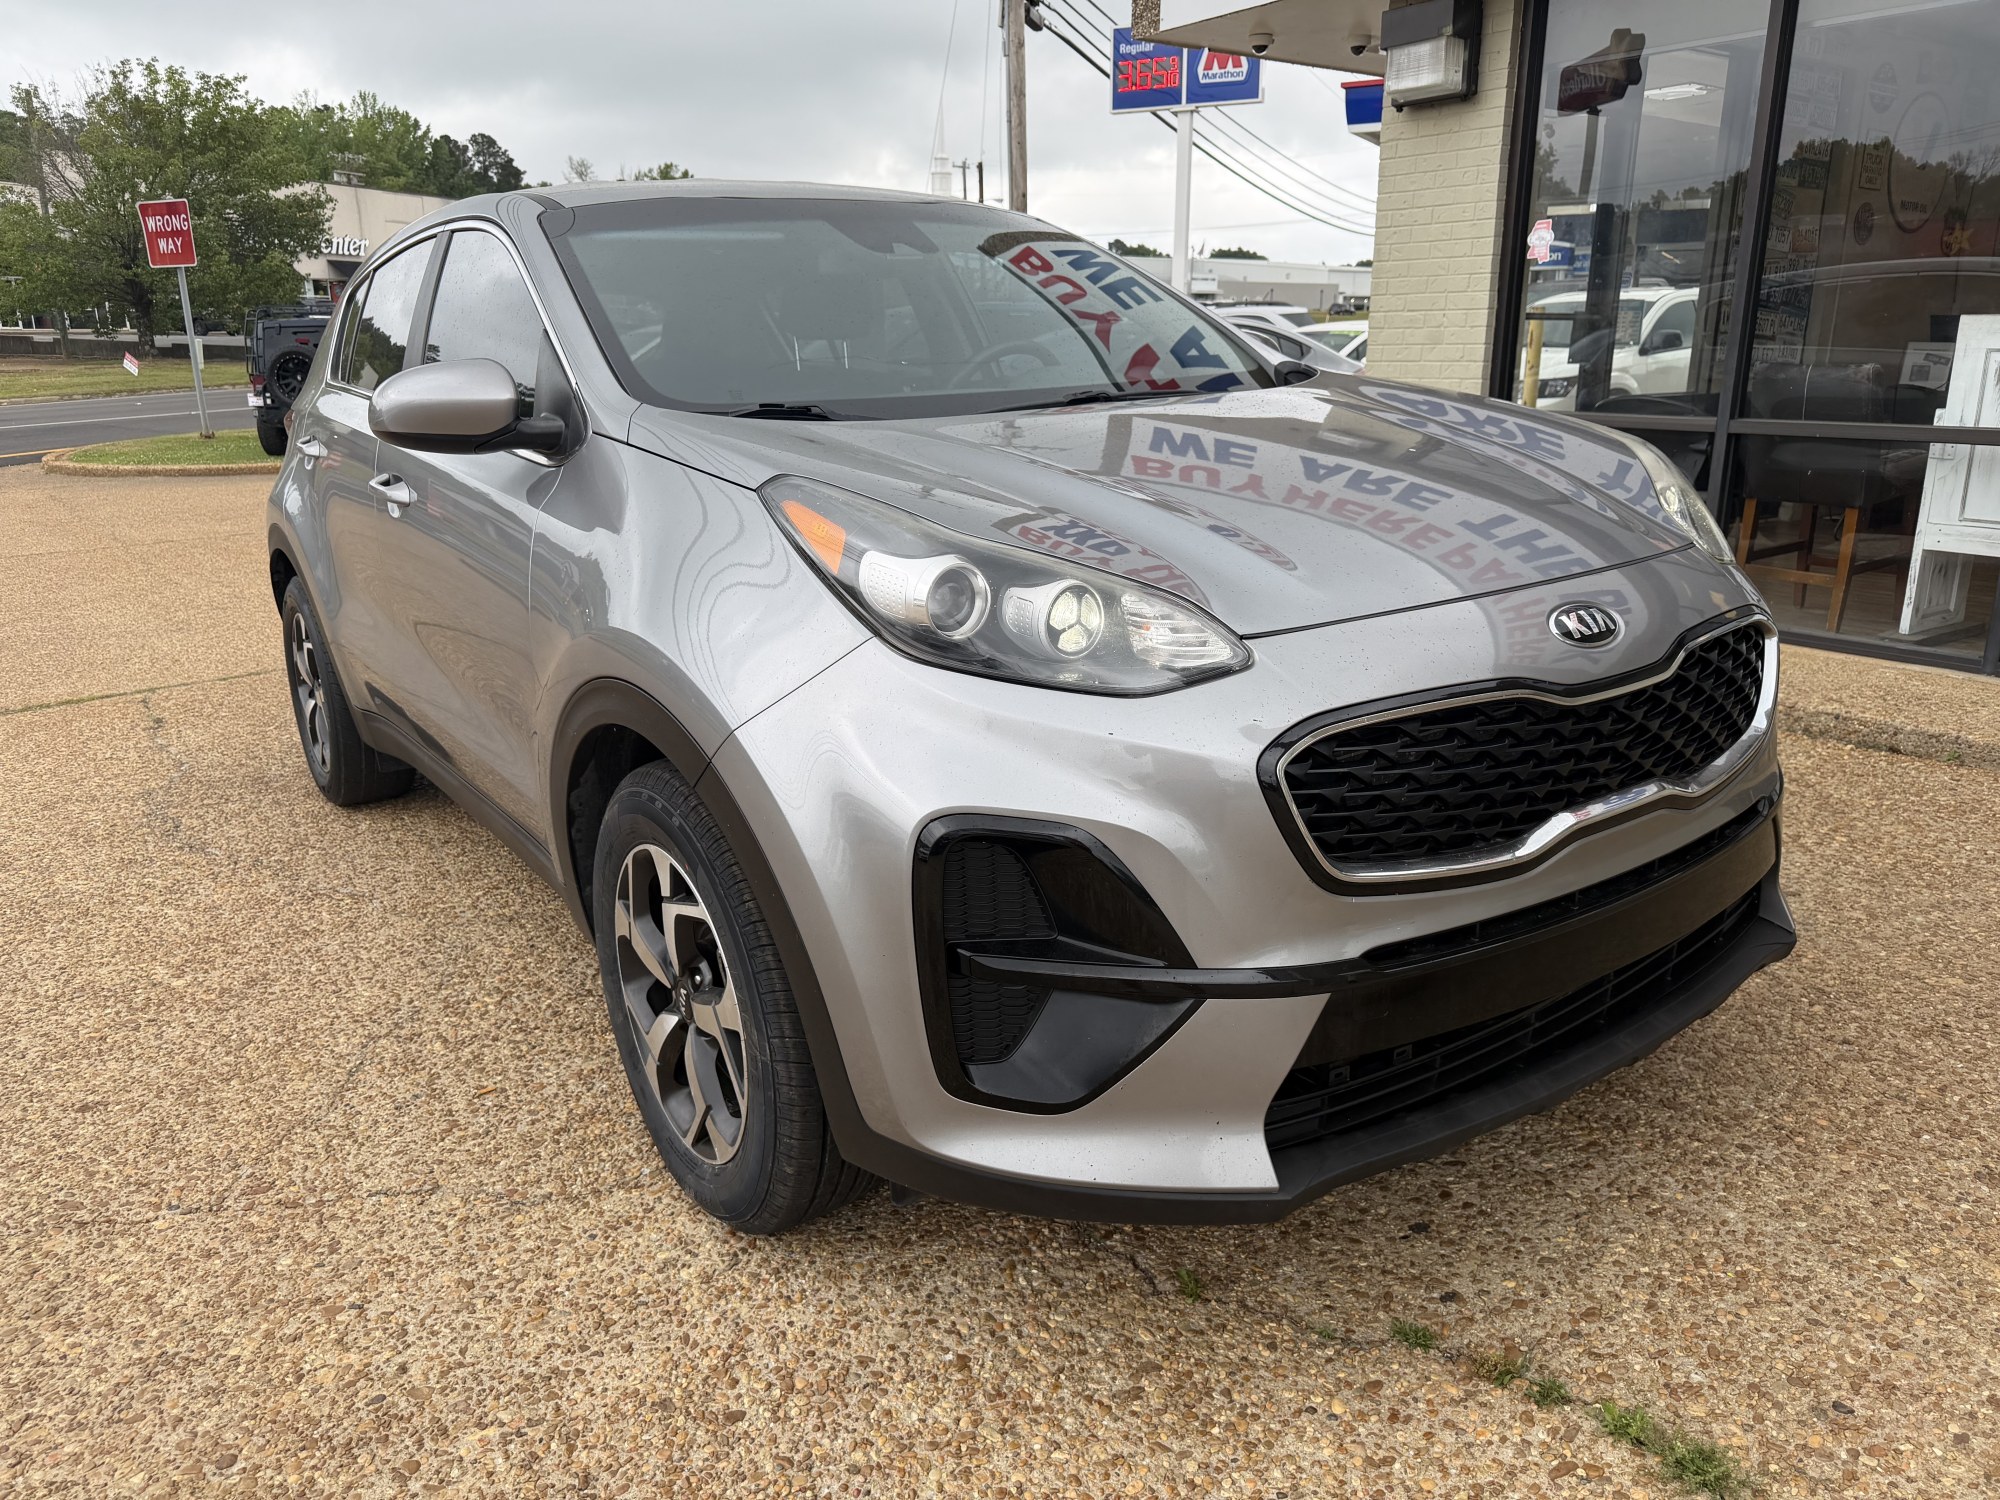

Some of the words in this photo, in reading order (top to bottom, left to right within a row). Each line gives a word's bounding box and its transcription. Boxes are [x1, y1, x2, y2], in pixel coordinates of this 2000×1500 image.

[1119, 43, 1154, 55] Regular
[1201, 69, 1244, 81] Marathon
[1900, 199, 1920, 212] MOTOR
[145, 214, 188, 232] WRONG
[157, 237, 182, 254] WAY
[320, 235, 369, 256] enter
[1558, 607, 1616, 639] KIA
[679, 987, 688, 1015] KIA
